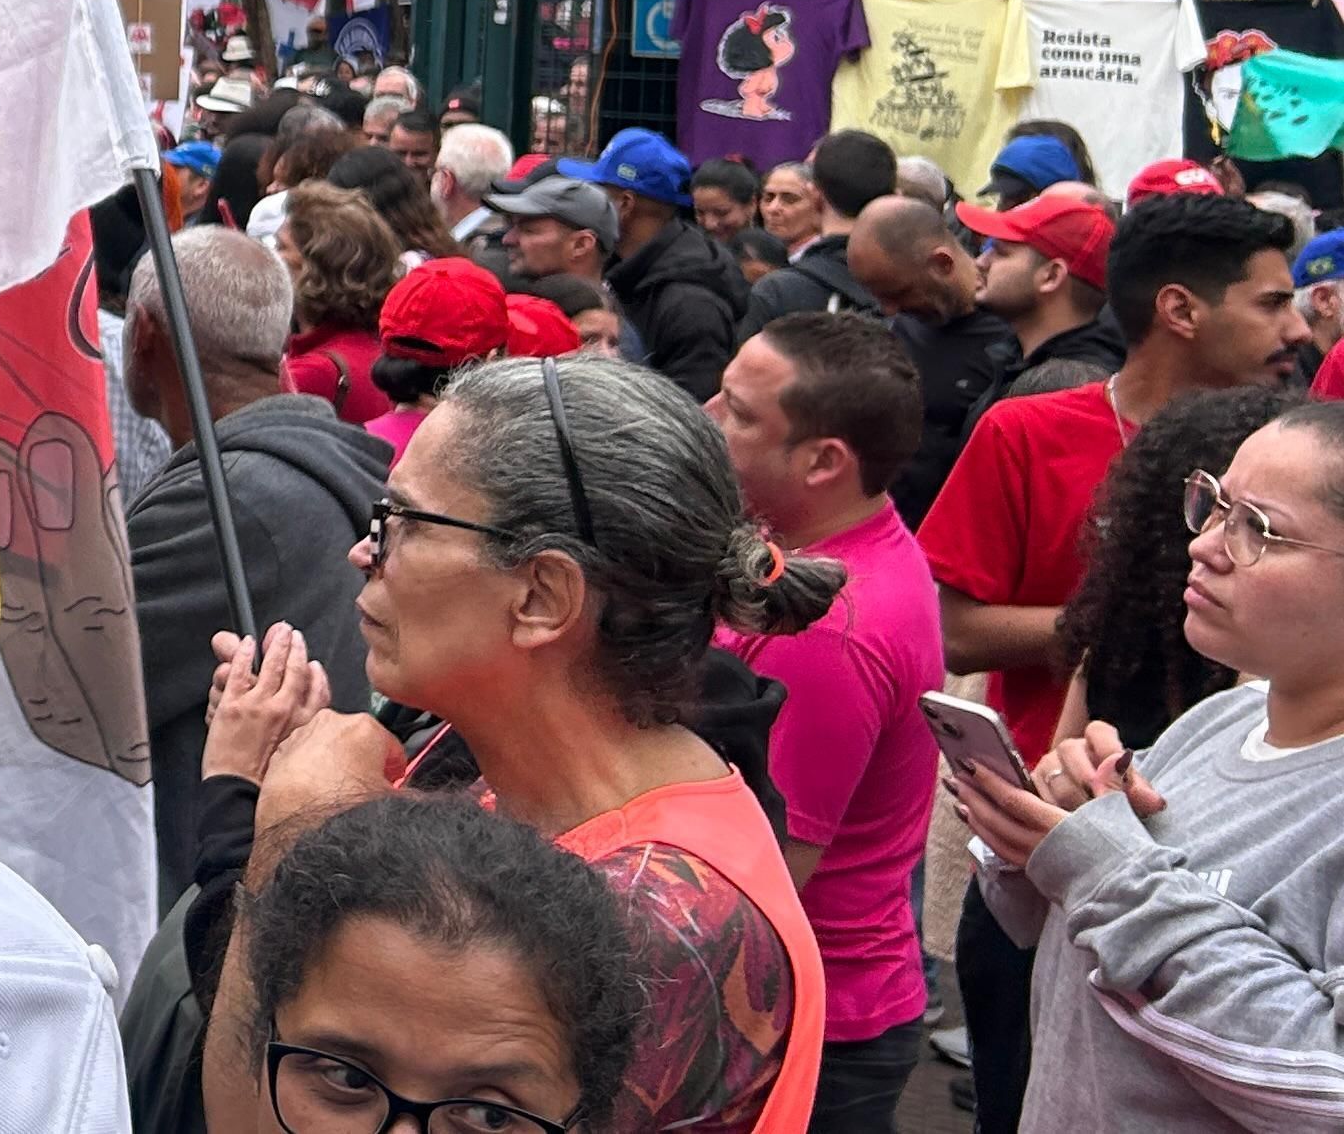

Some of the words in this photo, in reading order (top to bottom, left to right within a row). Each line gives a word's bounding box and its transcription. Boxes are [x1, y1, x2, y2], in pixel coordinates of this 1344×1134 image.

[1042, 28, 1111, 48] Resista
[1041, 48, 1094, 64] como
[1098, 52, 1142, 66] uma
[1040, 62, 1140, 85] araucária.
